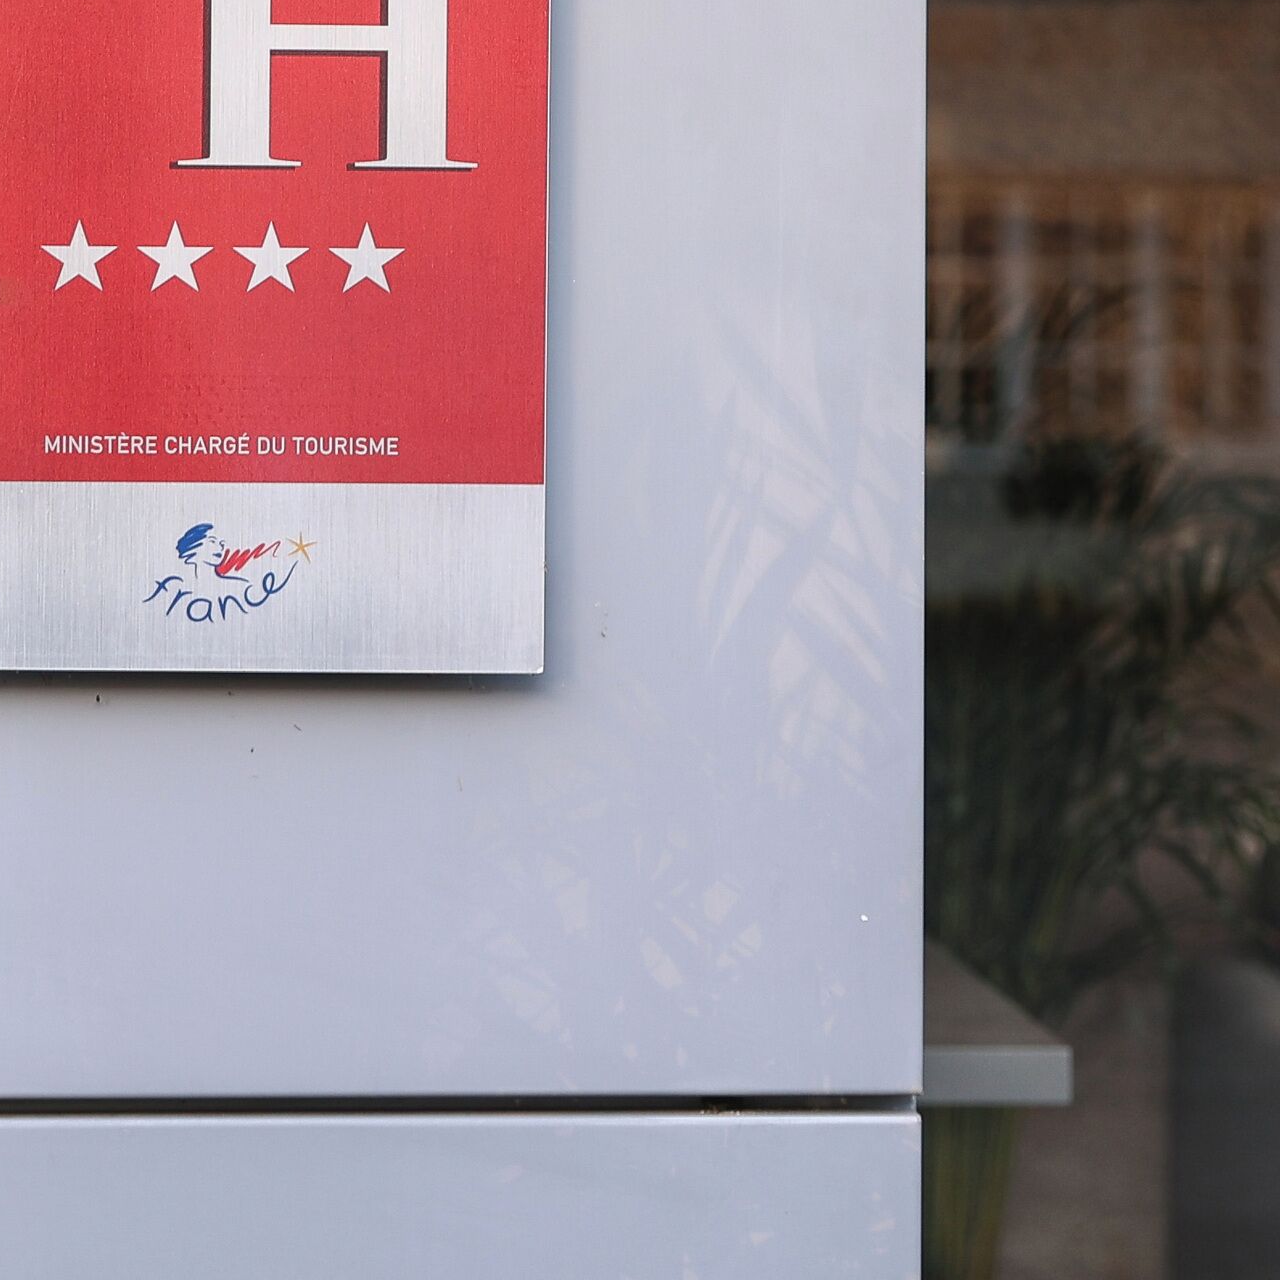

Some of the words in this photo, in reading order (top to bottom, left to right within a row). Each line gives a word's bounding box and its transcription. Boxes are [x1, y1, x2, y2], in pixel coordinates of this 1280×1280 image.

[44, 432, 158, 454] MINISTÈRE
[165, 433, 250, 455] CHARGÉ
[257, 437, 285, 455] DU
[292, 436, 399, 456] TOURISME
[142, 560, 298, 623] france
